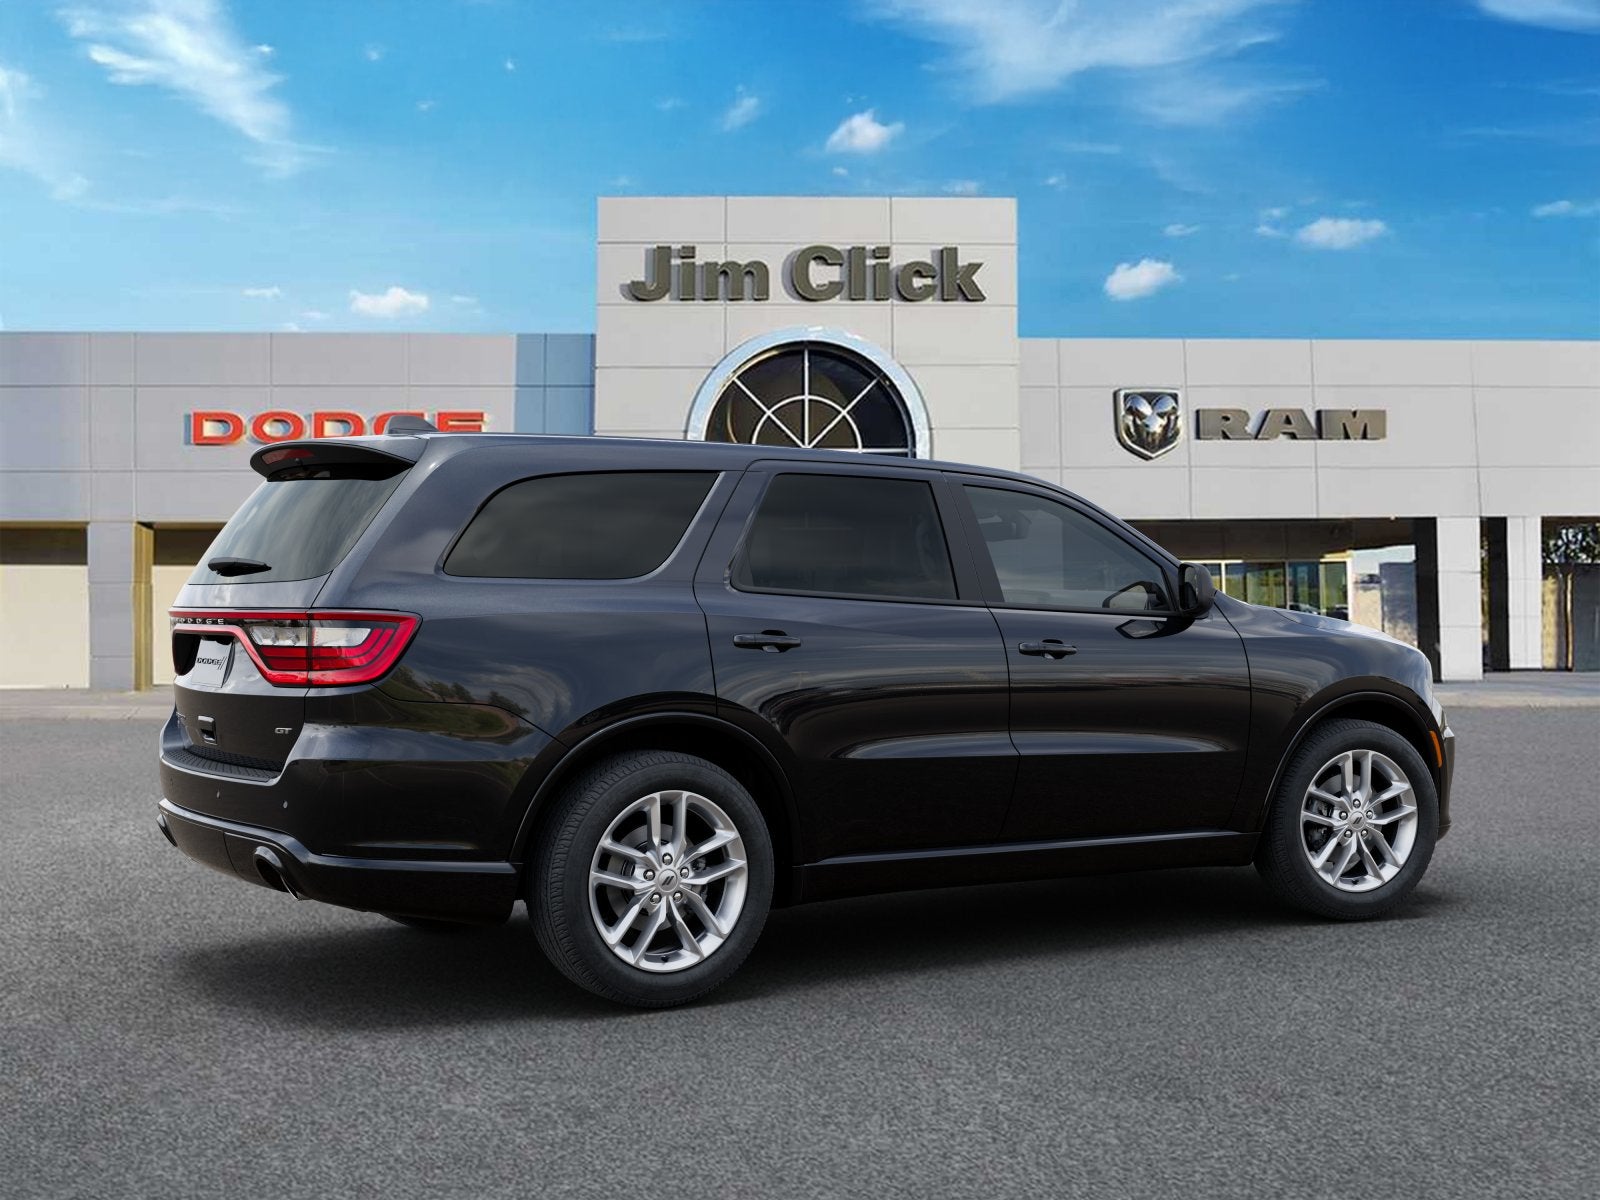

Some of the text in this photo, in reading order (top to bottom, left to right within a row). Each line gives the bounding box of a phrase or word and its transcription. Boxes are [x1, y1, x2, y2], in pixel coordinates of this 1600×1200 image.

[625, 245, 986, 302] Jim Click
[1195, 408, 1387, 440] RAM
[274, 727, 293, 735] GT
